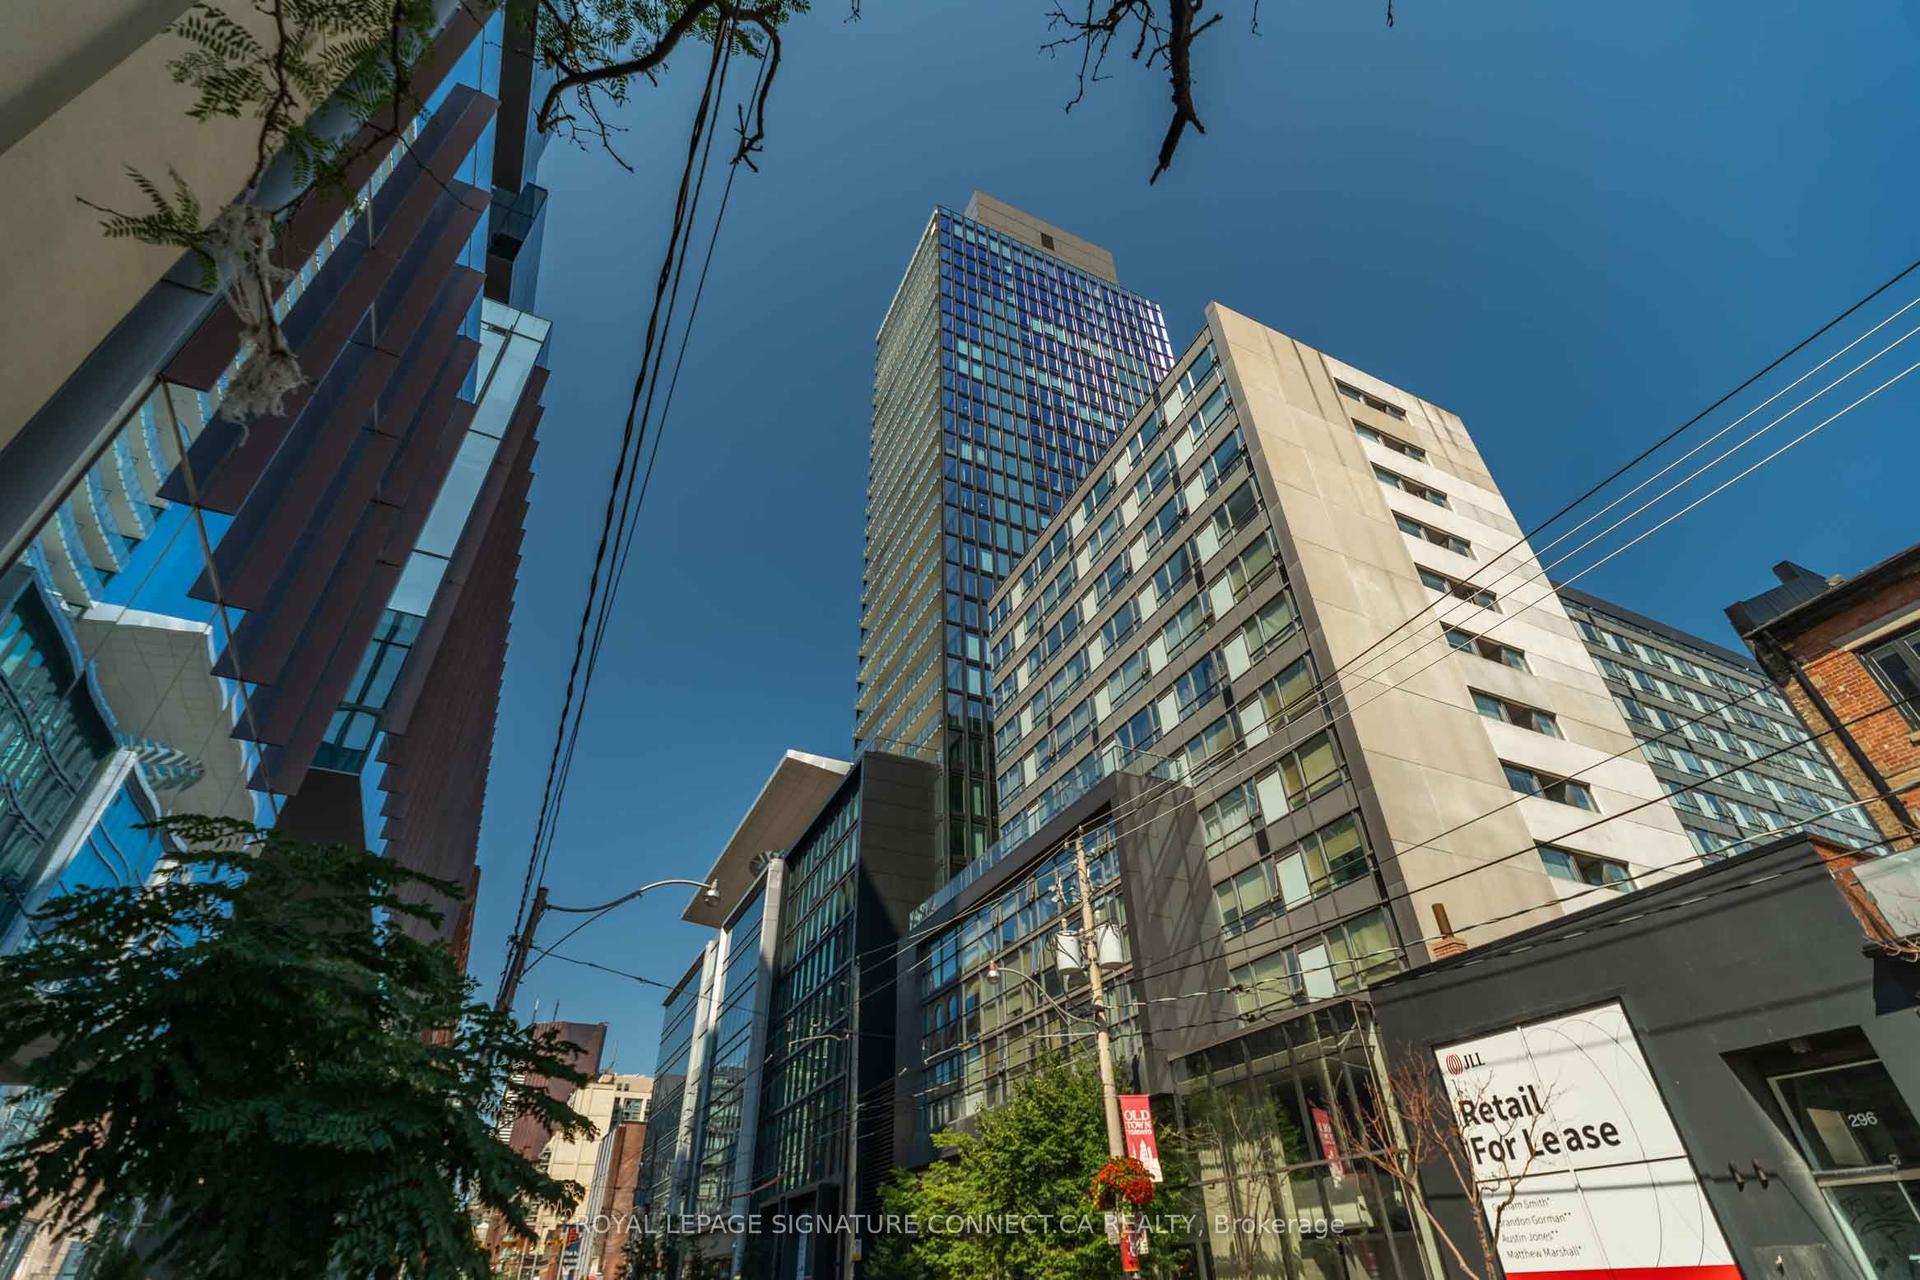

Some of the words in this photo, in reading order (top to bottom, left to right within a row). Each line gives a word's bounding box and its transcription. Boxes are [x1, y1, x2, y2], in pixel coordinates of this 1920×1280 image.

[1463, 1052, 1486, 1070] JLL
[1458, 1084, 1545, 1127] Retail
[1123, 1109, 1150, 1120] OLD
[1847, 1111, 1878, 1127] 296
[1125, 1120, 1152, 1130] TOWN
[1470, 1136, 1517, 1164] For
[1521, 1121, 1621, 1157] Lease
